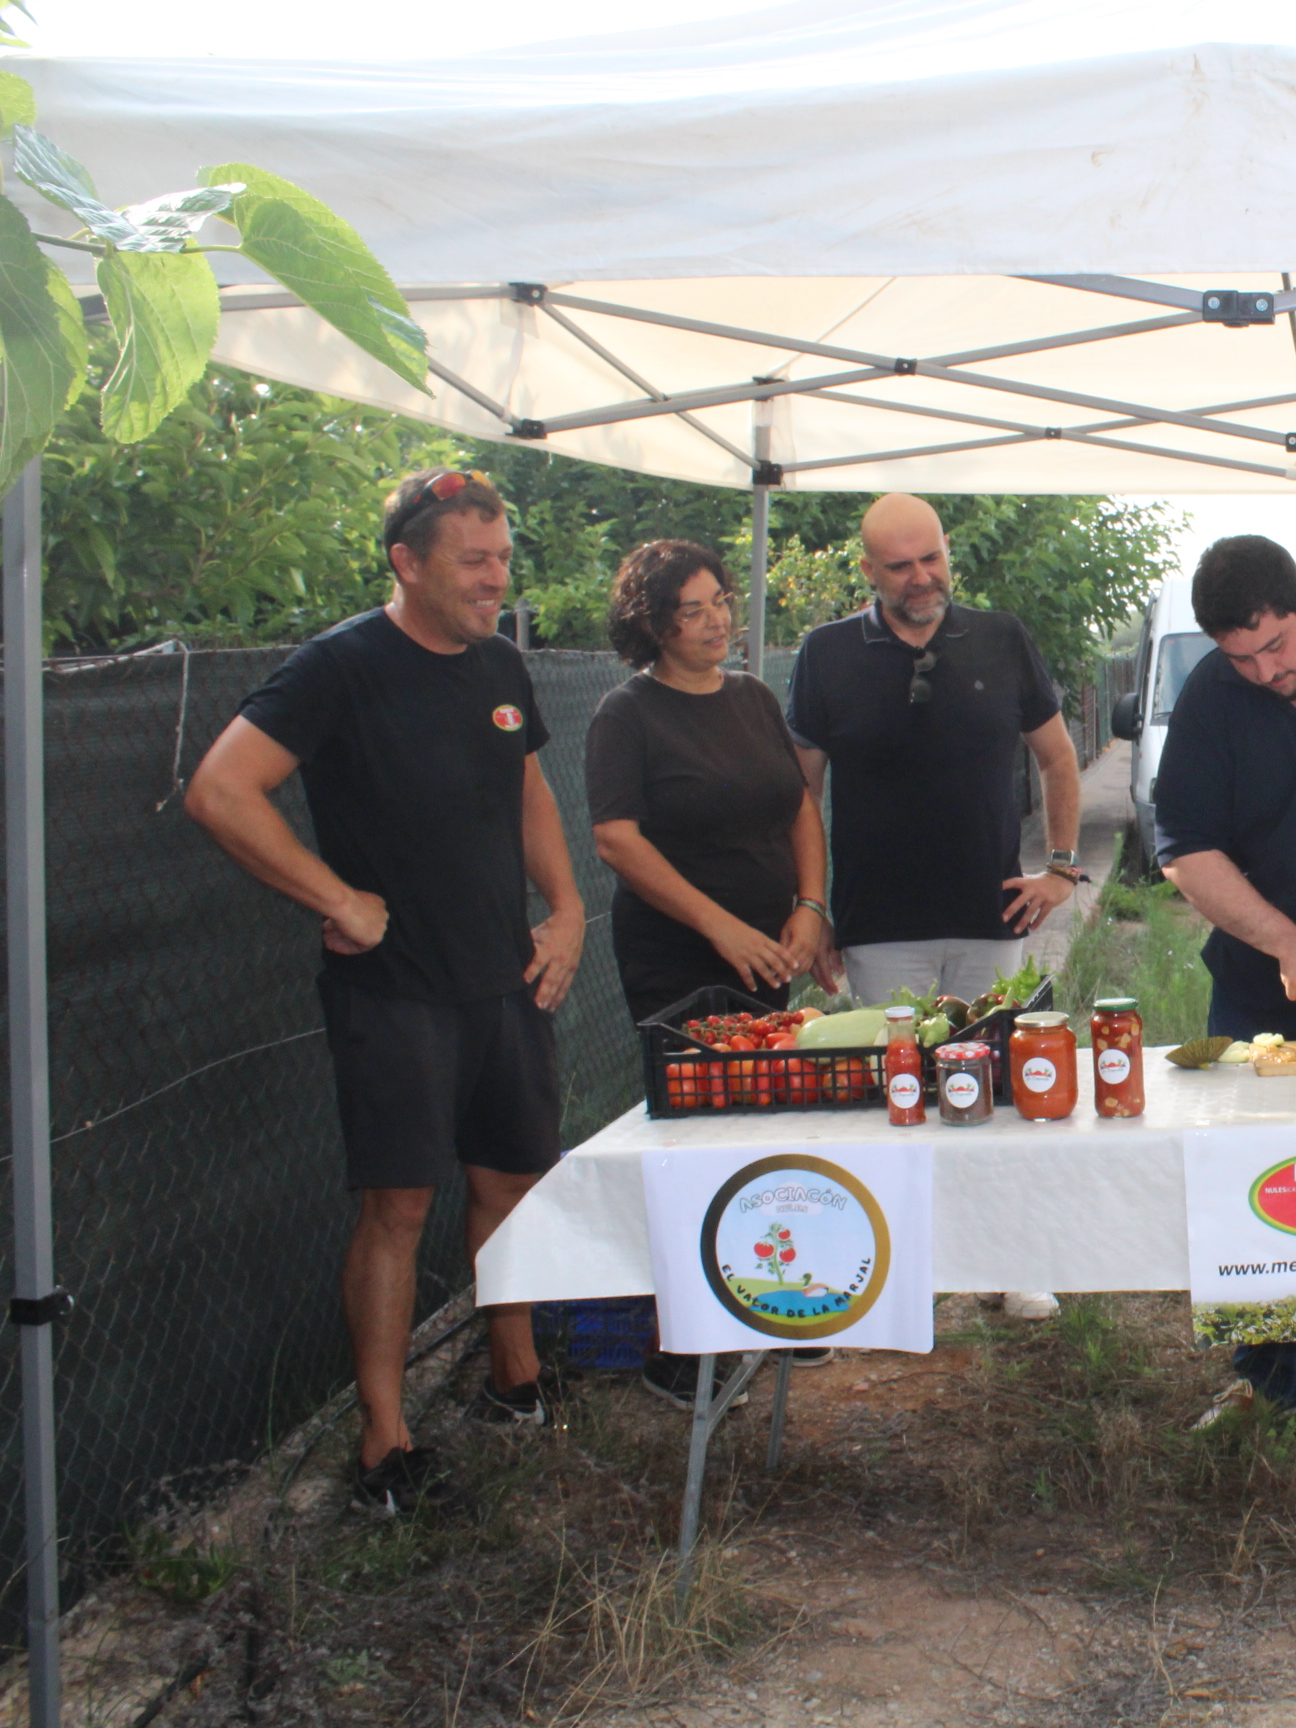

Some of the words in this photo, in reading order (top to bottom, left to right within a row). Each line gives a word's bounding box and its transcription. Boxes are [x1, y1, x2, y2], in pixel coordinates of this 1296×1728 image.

[739, 1187, 848, 1213] ASOCIACÓN
[721, 1264, 734, 1282] EL
[736, 1284, 779, 1315] VALOR
[786, 1309, 806, 1318] DE
[812, 1304, 830, 1316] LA
[834, 1257, 871, 1307] MARJAL
